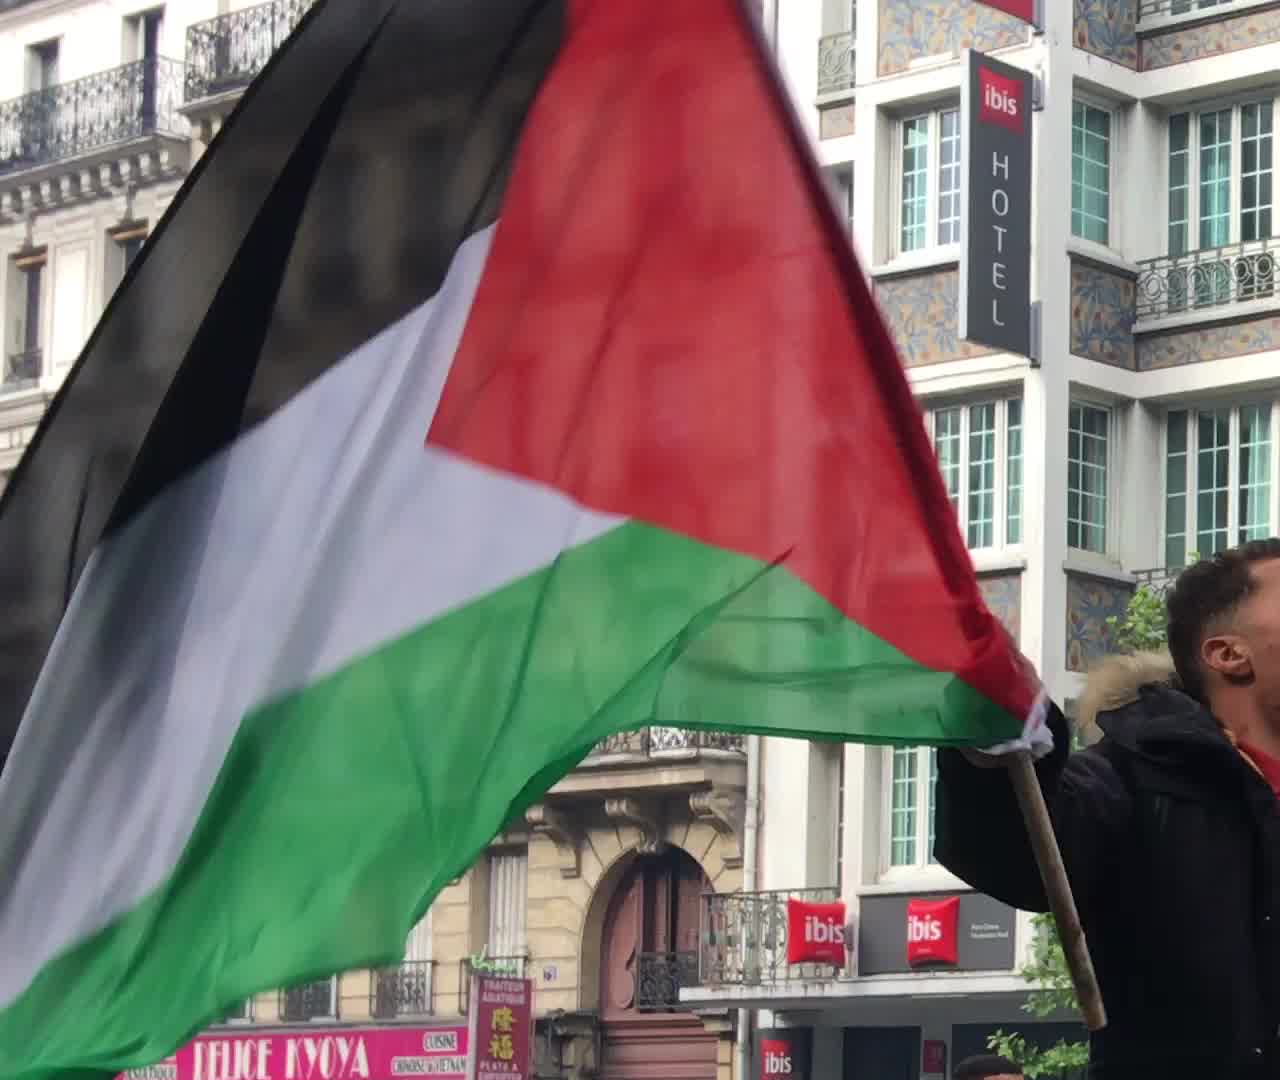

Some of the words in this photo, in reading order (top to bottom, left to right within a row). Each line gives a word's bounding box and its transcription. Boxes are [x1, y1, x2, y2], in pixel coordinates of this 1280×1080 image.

[984, 84, 1017, 115] ibis
[991, 151, 1009, 327] HOTEL
[805, 915, 844, 943] ibis
[907, 914, 941, 942] ibis
[285, 1034, 369, 1080] KYOYA
[765, 1051, 792, 1073] ibis
